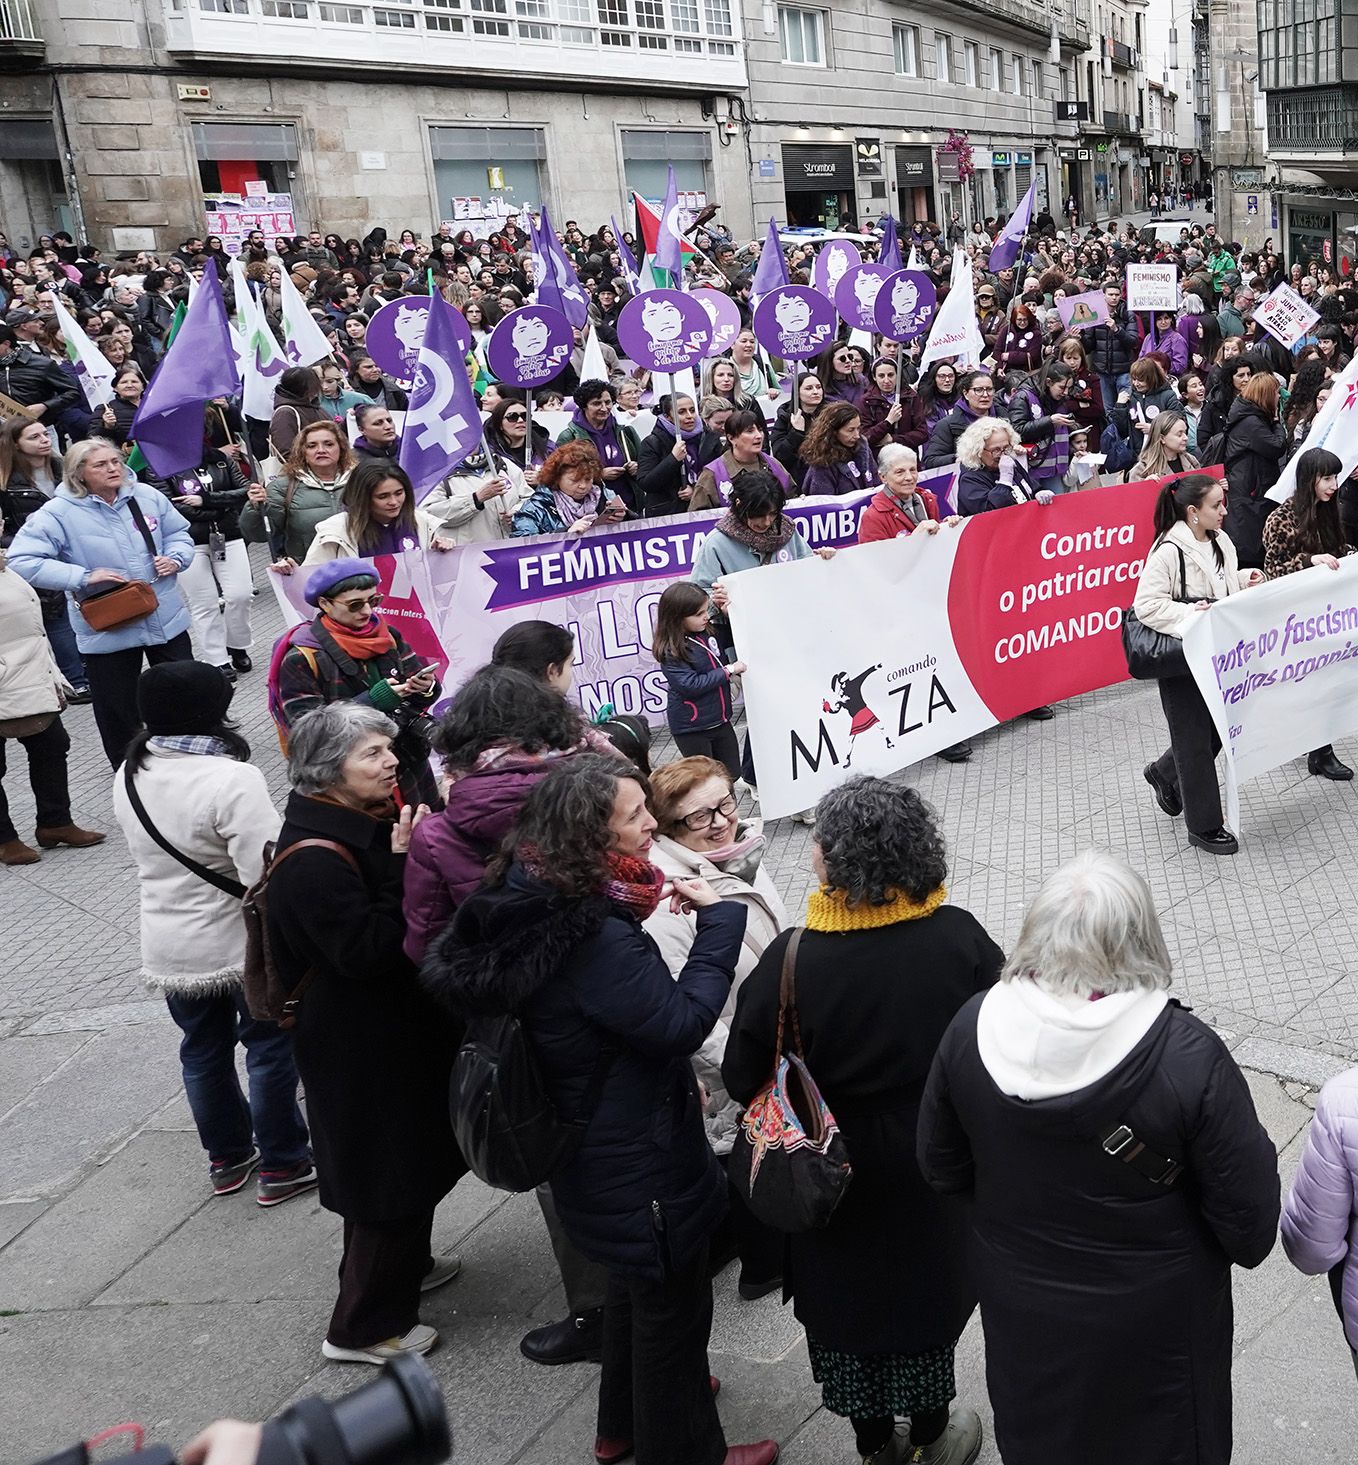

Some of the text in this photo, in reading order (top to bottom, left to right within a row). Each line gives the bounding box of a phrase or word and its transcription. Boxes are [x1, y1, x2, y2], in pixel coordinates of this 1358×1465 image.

[1133, 272, 1171, 283] FEMINISMO
[1040, 524, 1135, 560] Contra
[999, 591, 1015, 612] o
[994, 606, 1123, 664] COMANDO
[1258, 628, 1279, 658] ao
[887, 654, 937, 683] comando
